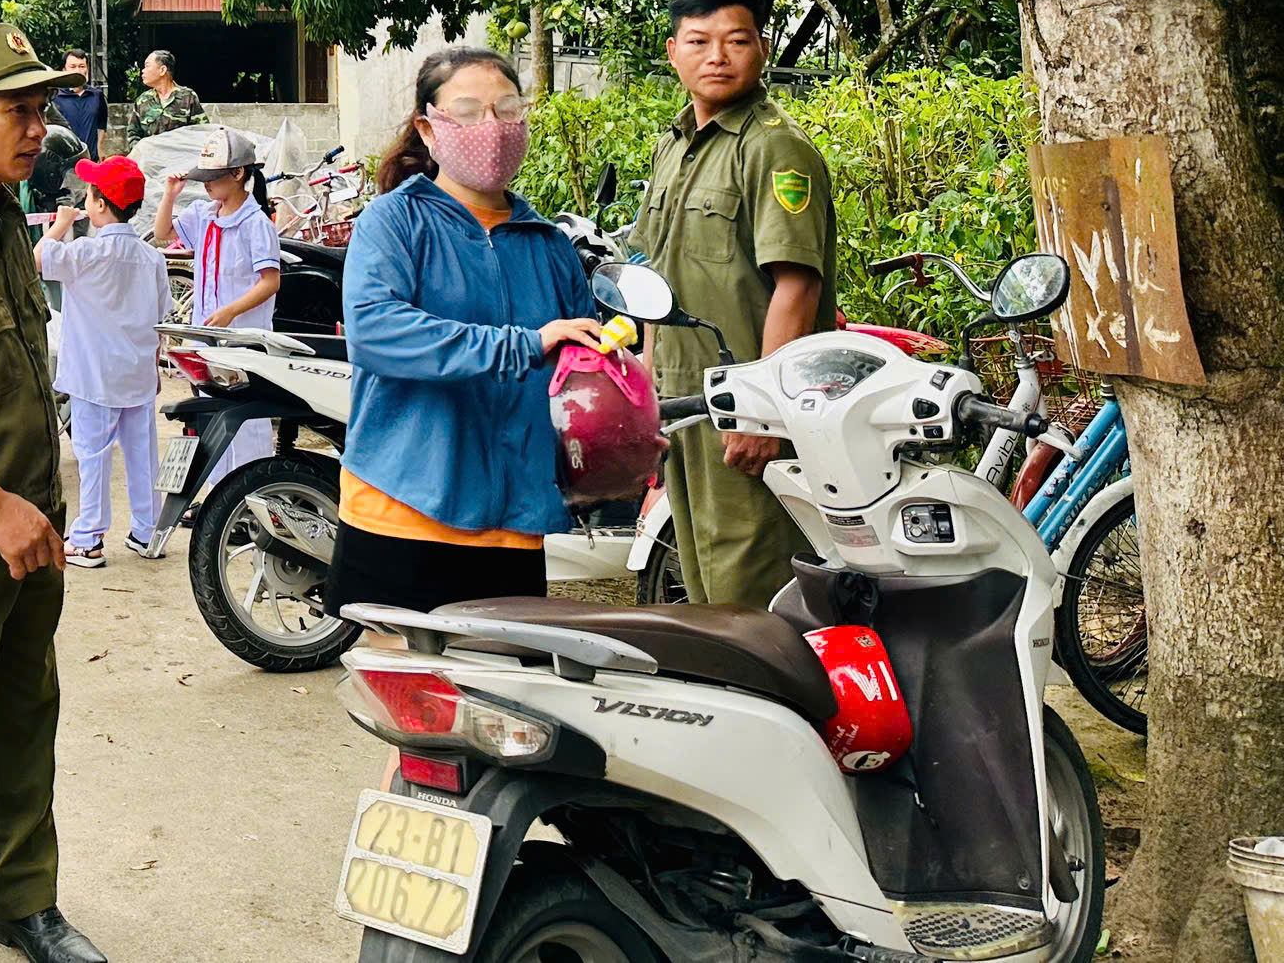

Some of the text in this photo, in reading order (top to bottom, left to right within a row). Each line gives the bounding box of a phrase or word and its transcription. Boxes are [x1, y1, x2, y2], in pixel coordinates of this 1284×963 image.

[591, 696, 714, 726] VISION
[417, 792, 458, 807] HONDA
[368, 804, 465, 875] 23-B1
